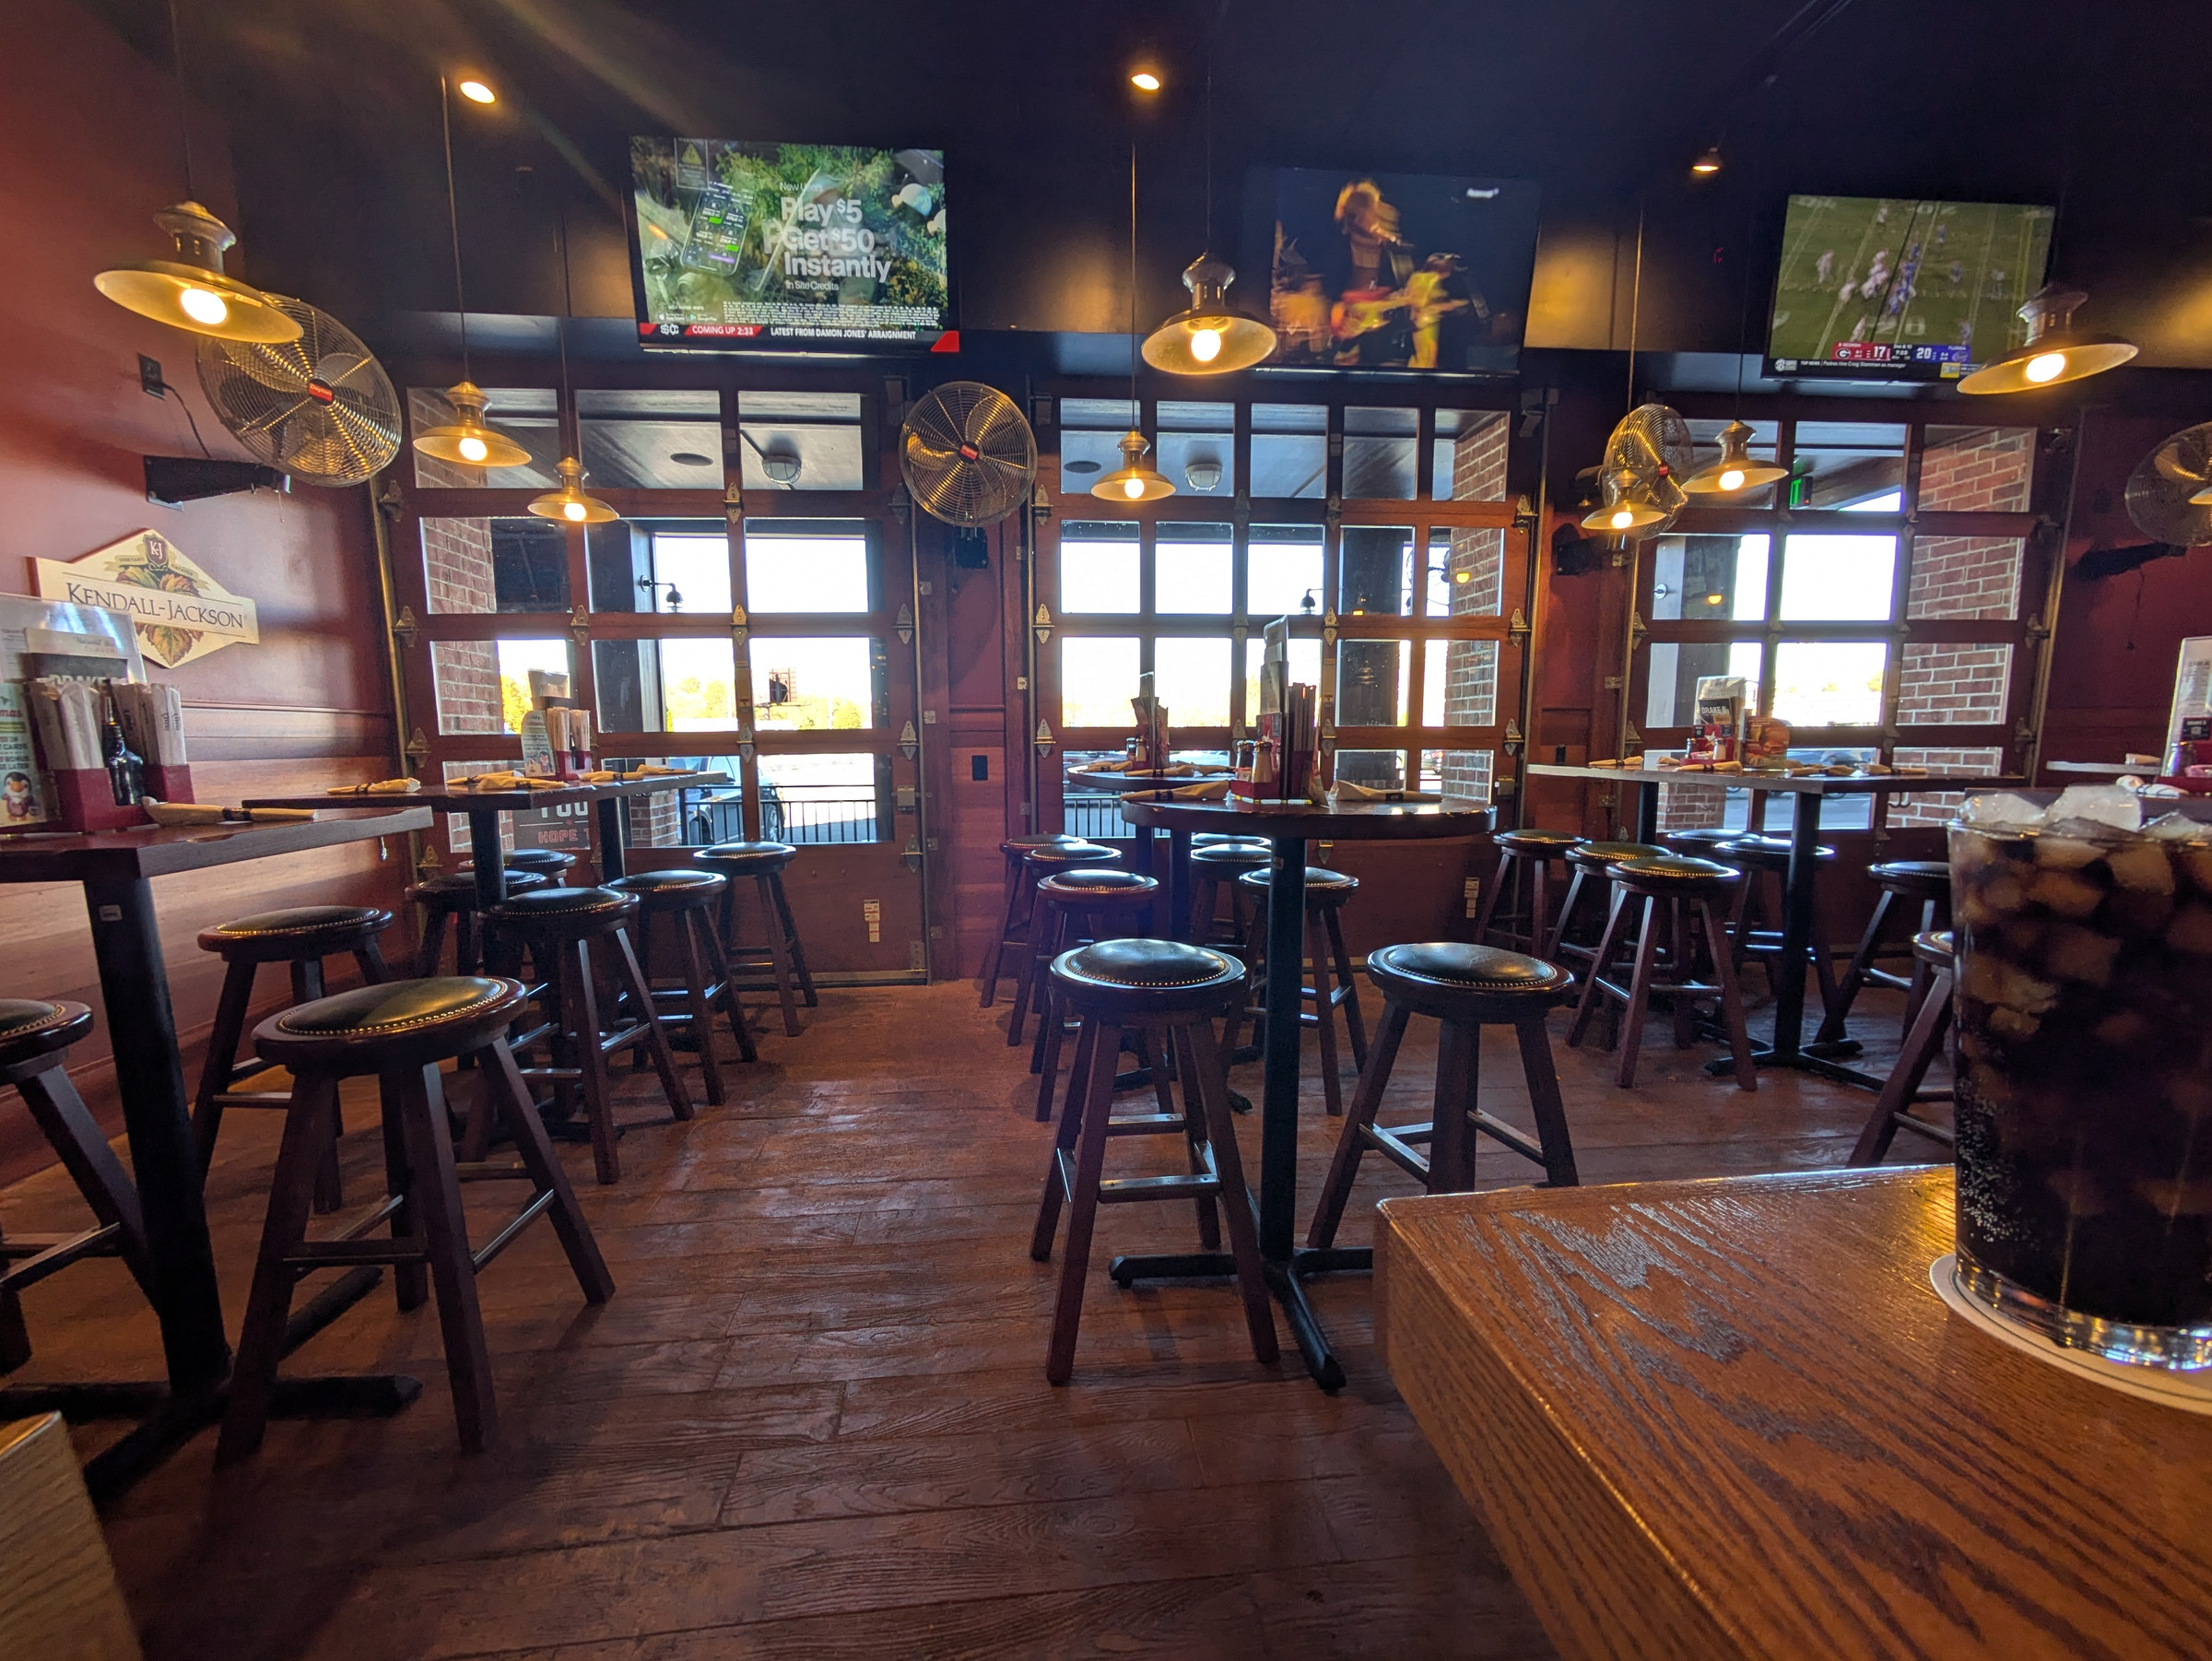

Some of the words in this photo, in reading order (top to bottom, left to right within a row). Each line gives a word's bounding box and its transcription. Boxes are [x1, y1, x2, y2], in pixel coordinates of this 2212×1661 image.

[781, 196, 834, 227] Play
[836, 197, 863, 223] $5
[782, 226, 830, 252] Get
[831, 227, 875, 253] $50
[784, 252, 892, 284] Instantly
[692, 325, 724, 336] COMING
[725, 325, 735, 336] UP
[771, 327, 794, 336] LATEST
[795, 327, 815, 337] FROM
[816, 328, 842, 338] DAMON
[868, 329, 916, 340] ARRAIGNMENT
[1874, 346, 1887, 358] 17
[1916, 347, 1932, 359] 20
[1790, 478, 1802, 506] IT
[66, 582, 244, 629] KENDALL-JACKSON
[538, 829, 578, 844] HOPE
